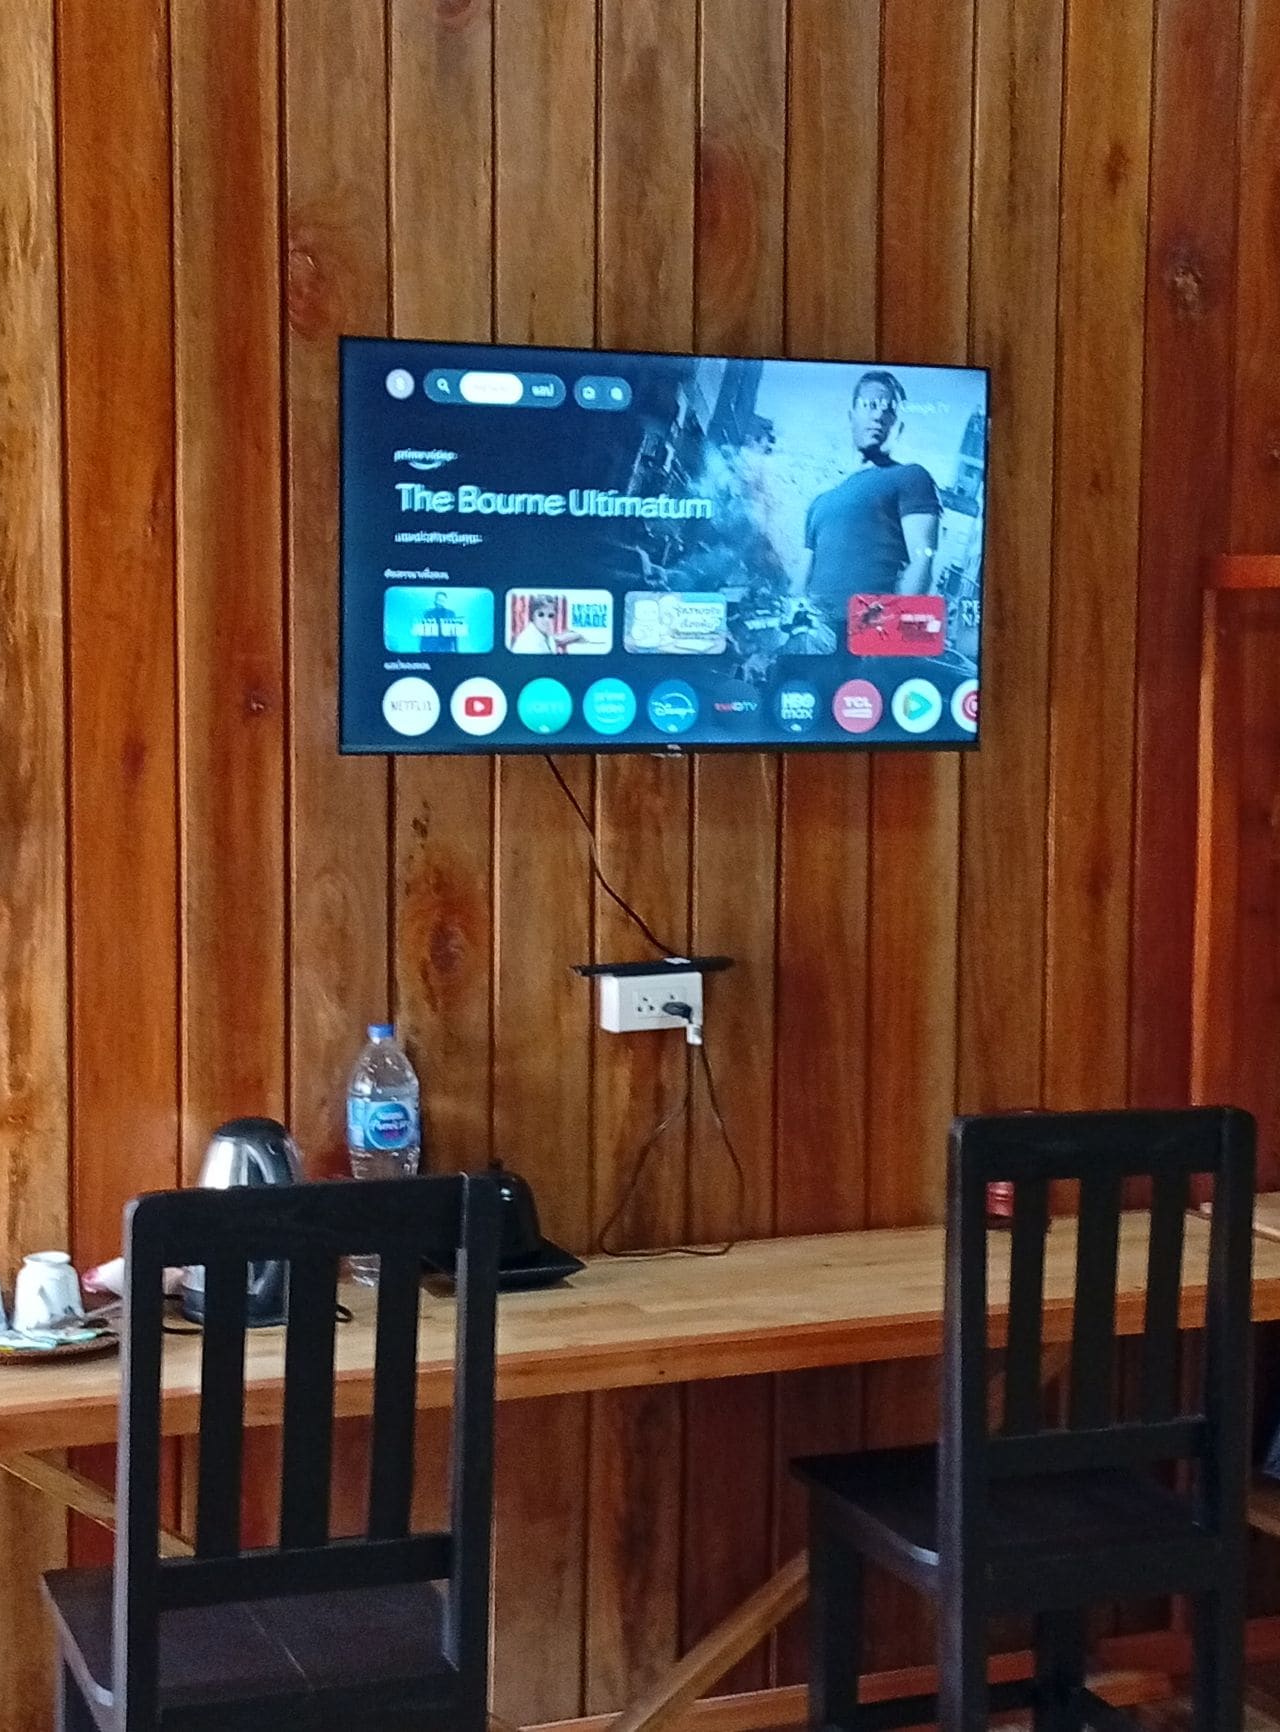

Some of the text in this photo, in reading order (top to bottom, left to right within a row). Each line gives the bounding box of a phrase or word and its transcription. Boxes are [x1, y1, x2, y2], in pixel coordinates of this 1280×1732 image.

[395, 483, 714, 519] The Bourne Ultimatum
[843, 696, 872, 708] TCL
